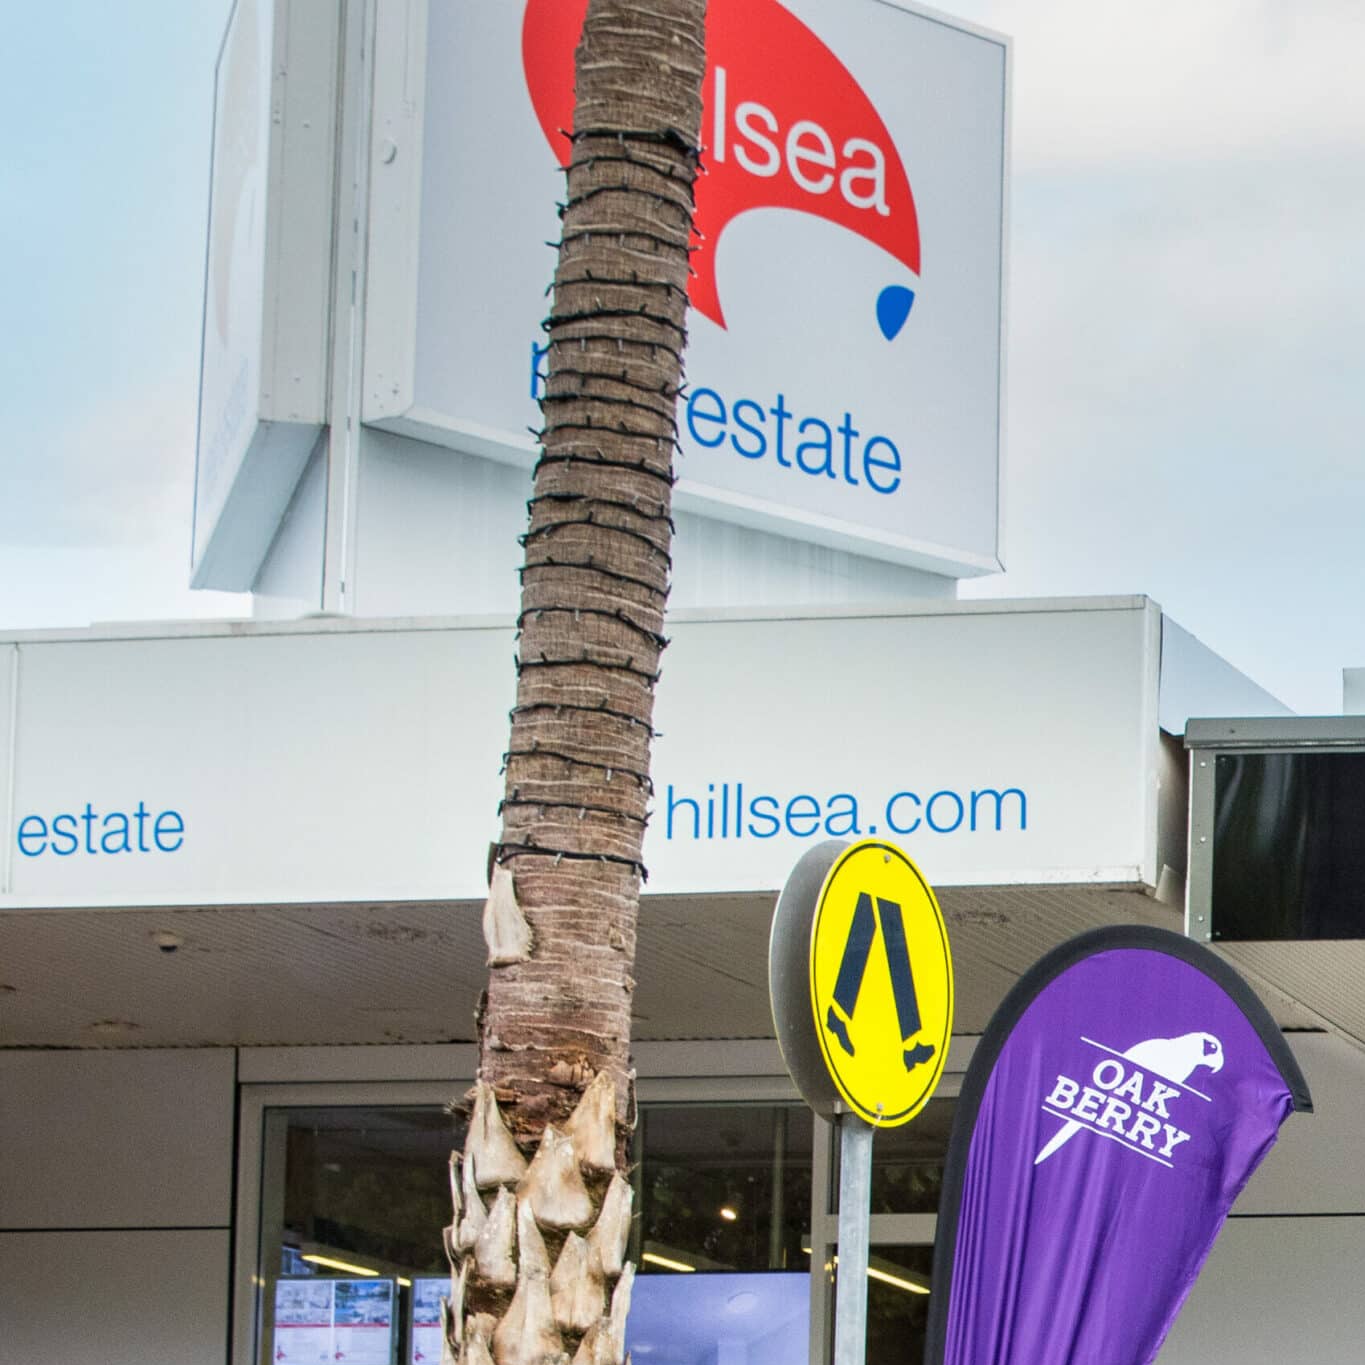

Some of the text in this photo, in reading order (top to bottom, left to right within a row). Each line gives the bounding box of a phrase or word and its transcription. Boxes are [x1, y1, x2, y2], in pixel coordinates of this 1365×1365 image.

[714, 66, 890, 217] lsea
[686, 387, 902, 495] estate
[16, 800, 185, 858] estate
[665, 783, 1028, 840] hillsea.com
[1045, 1075, 1191, 1158] BERRY
[1093, 1059, 1181, 1119] OAK
